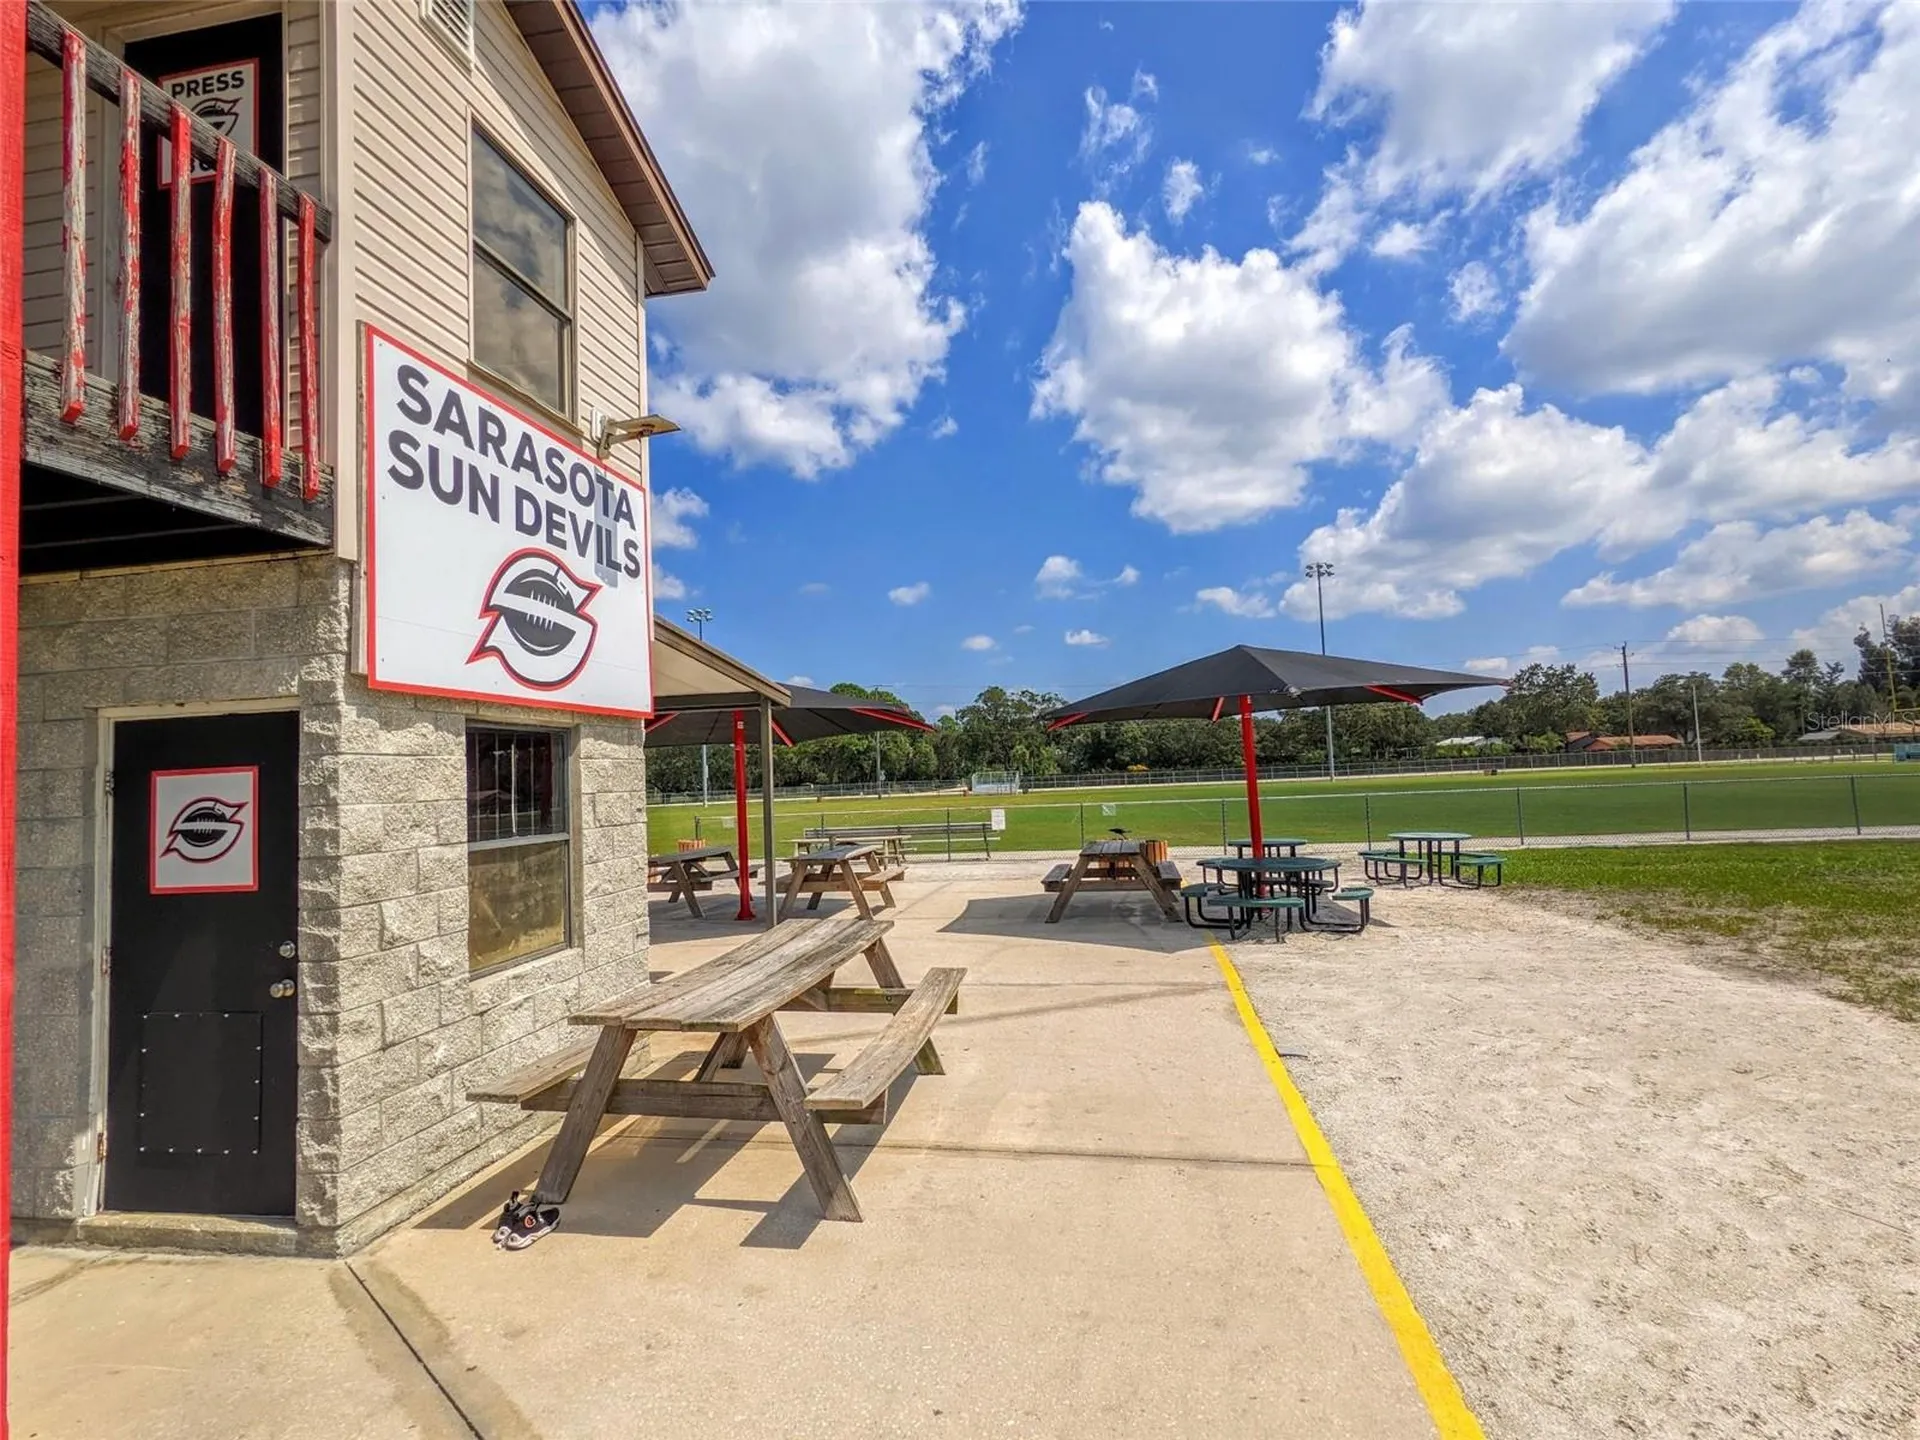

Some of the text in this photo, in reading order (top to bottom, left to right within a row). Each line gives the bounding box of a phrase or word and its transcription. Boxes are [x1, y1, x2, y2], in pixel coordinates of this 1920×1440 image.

[171, 70, 245, 98] PRESS
[387, 429, 641, 579] SUN DEVILS
[396, 364, 636, 531] SARASOTA
